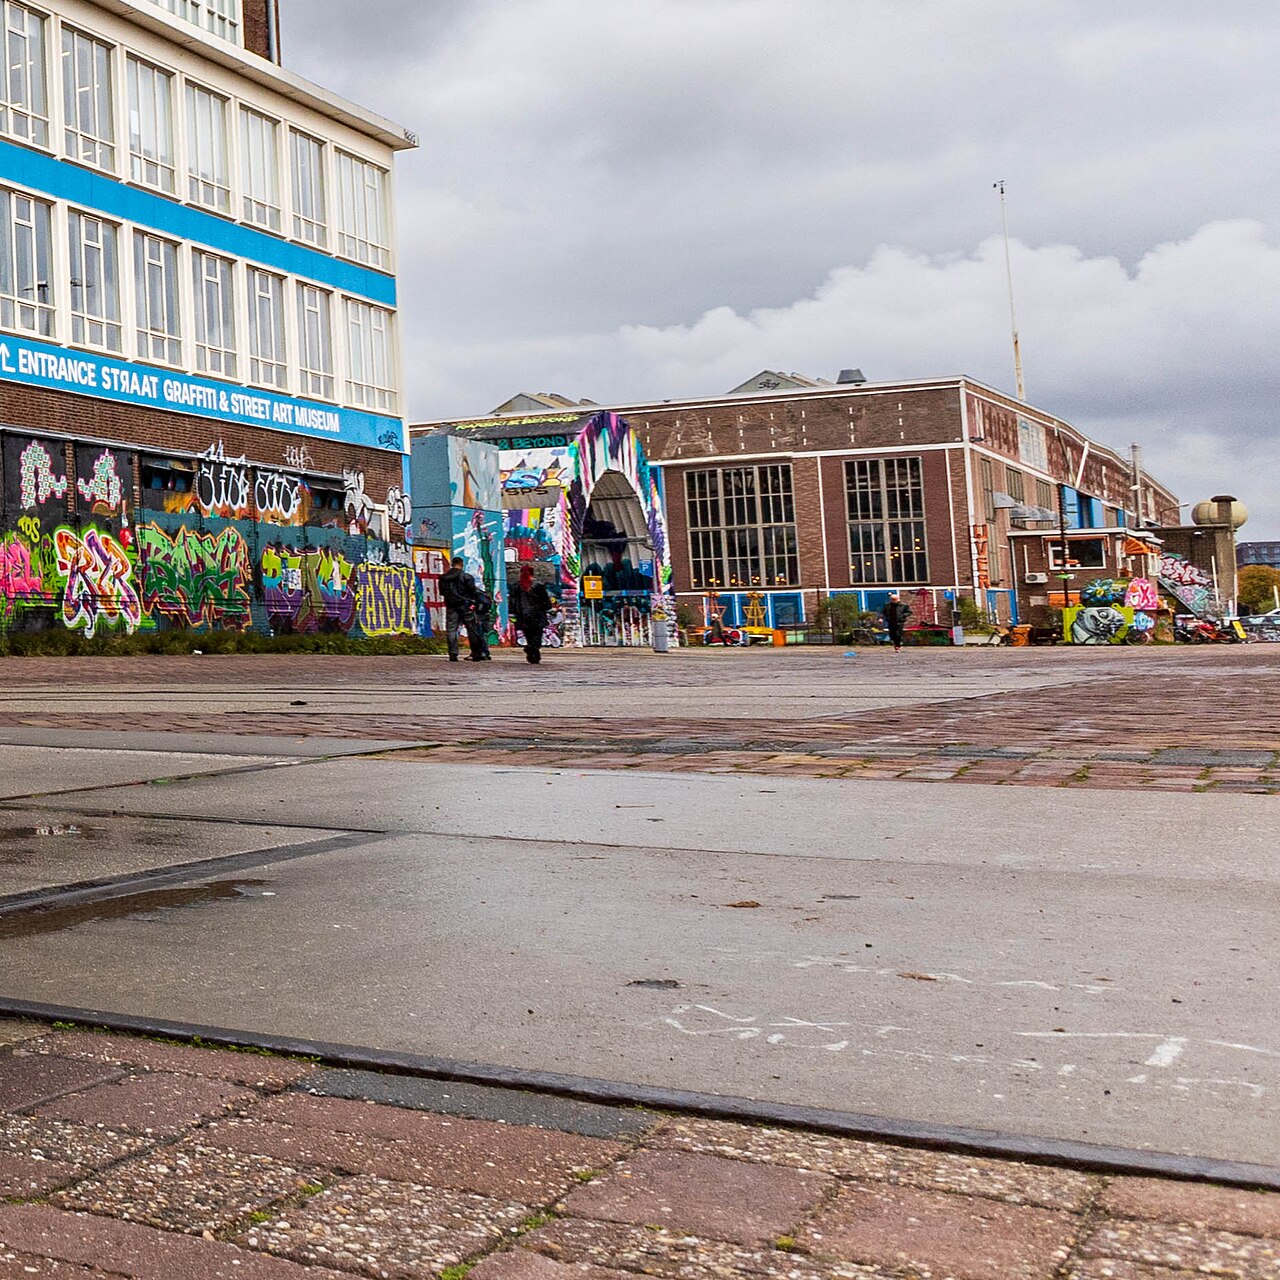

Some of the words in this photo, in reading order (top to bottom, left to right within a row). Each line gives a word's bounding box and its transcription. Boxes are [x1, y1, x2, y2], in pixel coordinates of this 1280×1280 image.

[19, 348, 97, 387] ENTRANCE
[163, 379, 217, 410] GRAFFITI
[219, 391, 230, 411] &
[231, 394, 271, 420] STREET
[272, 403, 293, 424] ART
[295, 406, 340, 433] MUSEUM
[512, 435, 566, 449] BEYOND
[18, 515, 41, 543] TOS
